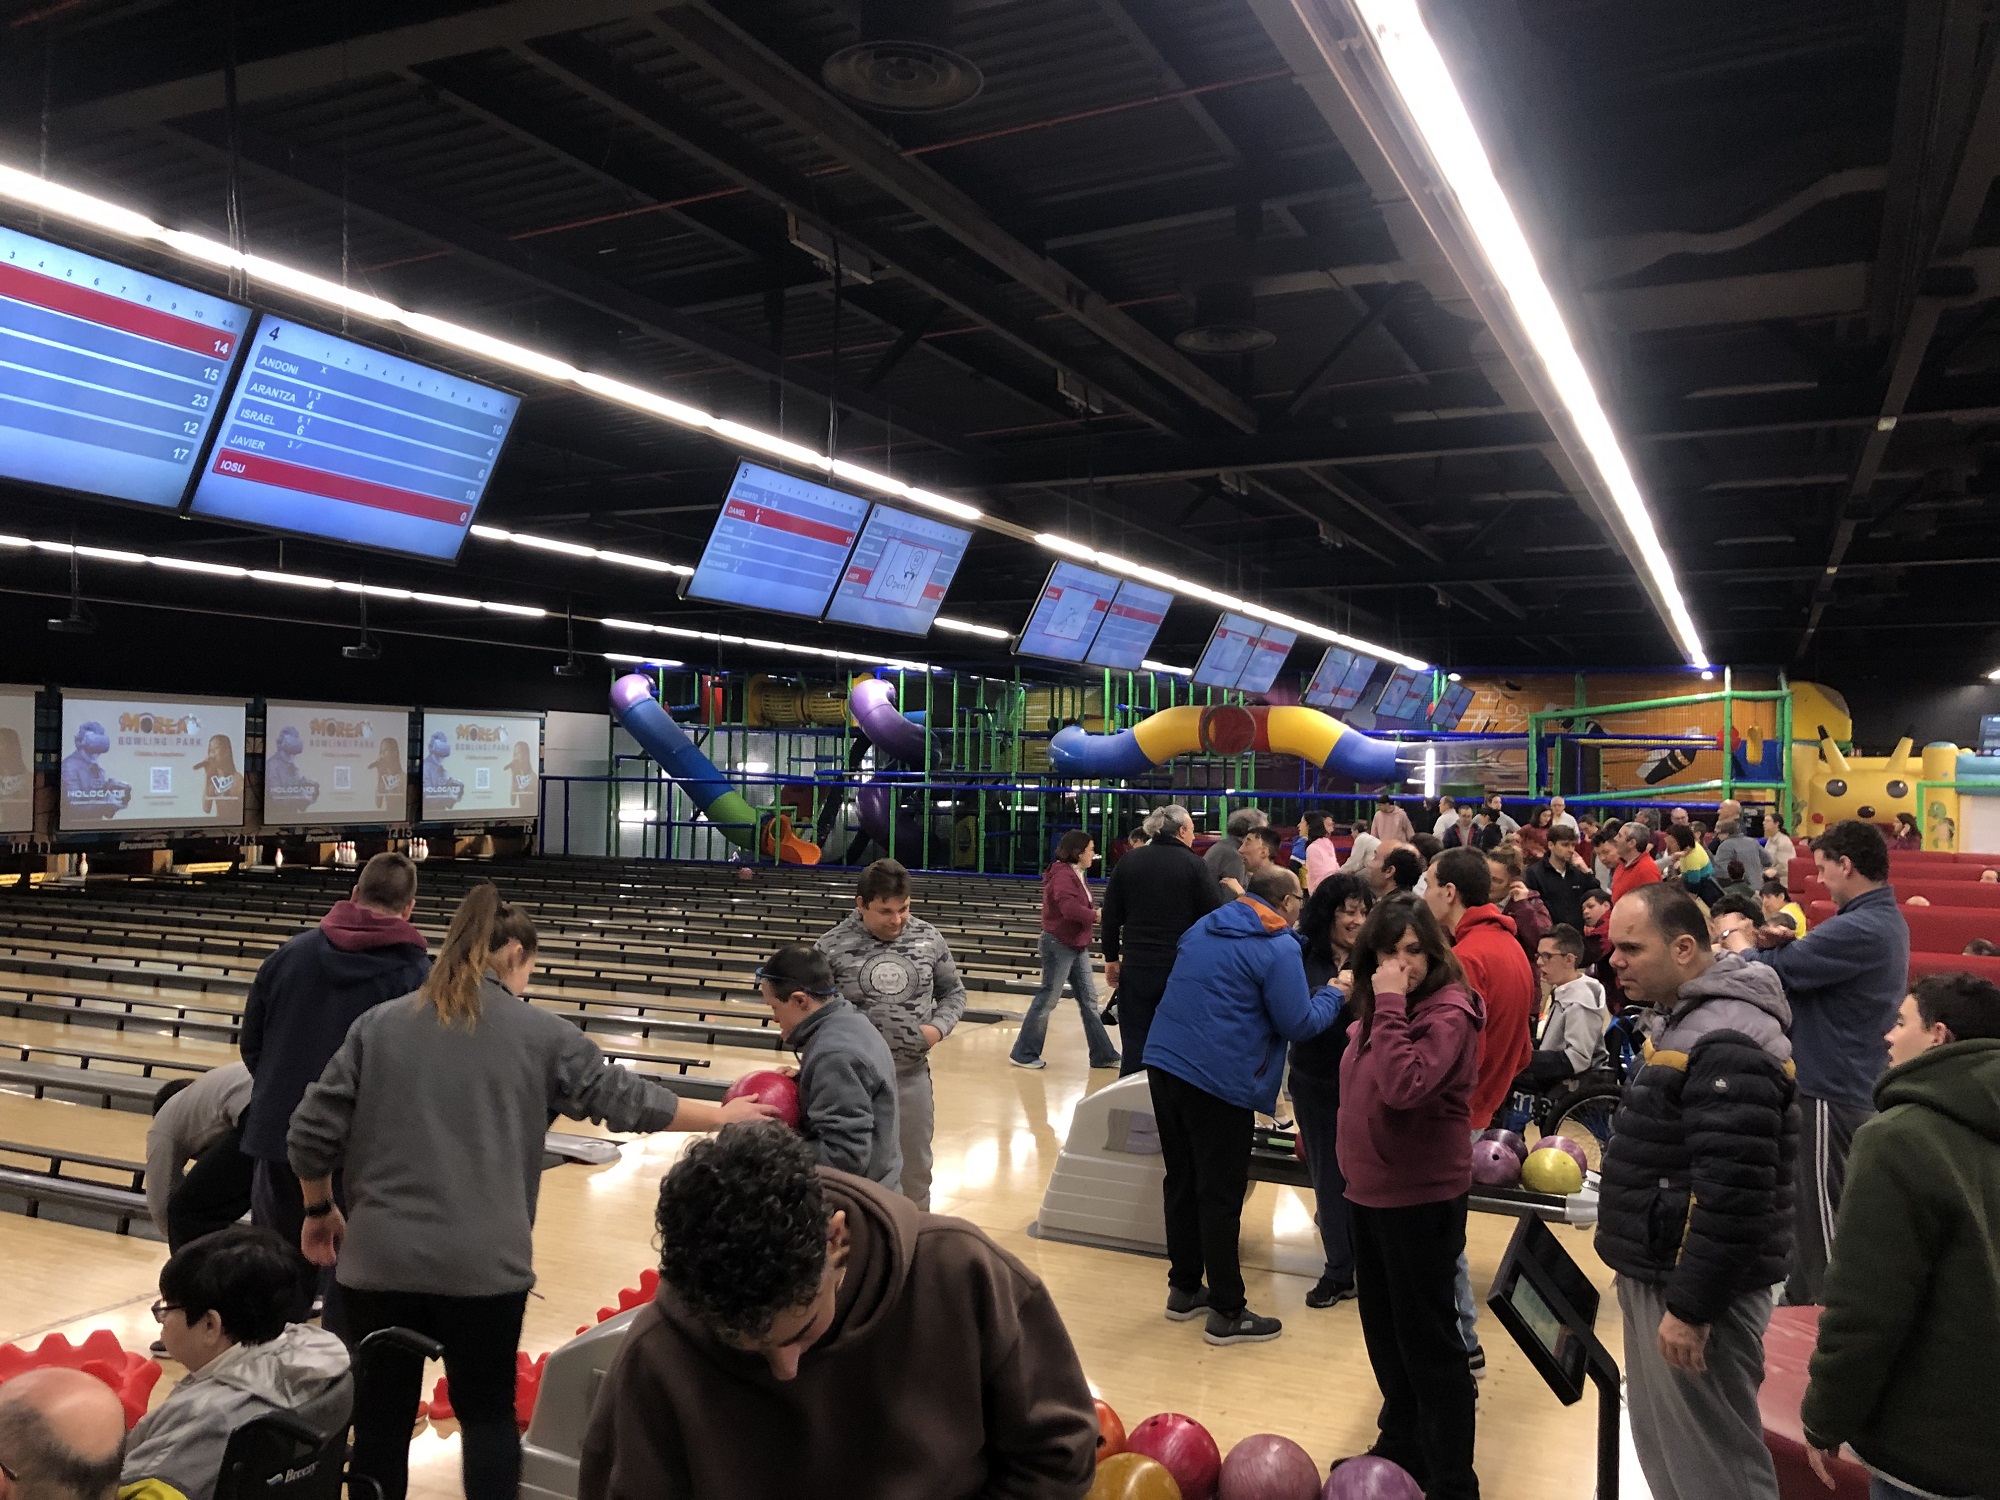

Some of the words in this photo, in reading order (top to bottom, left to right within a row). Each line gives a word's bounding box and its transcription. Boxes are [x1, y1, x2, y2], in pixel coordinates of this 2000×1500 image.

[9, 250, 16, 260] 3
[38, 260, 45, 268] 4
[66, 269, 73, 277] 5
[93, 277, 100, 286] 6
[120, 286, 127, 294] 7
[145, 294, 152, 302] 8
[170, 302, 177, 310] 9
[194, 310, 203, 318] 10
[268, 326, 281, 341] 4
[213, 340, 229, 355] 14
[203, 366, 219, 381] 15
[191, 393, 209, 408] 23
[259, 356, 300, 375] ANDONI
[319, 366, 328, 374] X
[492, 424, 503, 435] 10
[250, 382, 297, 403] ARANTZA
[305, 400, 315, 411] 4
[486, 447, 494, 457] 4
[182, 420, 199, 435] 12
[240, 408, 276, 426] ISRAEL
[296, 424, 305, 435] 6
[478, 468, 485, 479] 6
[173, 448, 189, 461] 17
[230, 435, 266, 450] JAVIER
[465, 489, 476, 500] 10
[741, 468, 749, 479] 5
[220, 460, 246, 474] IOSU
[459, 511, 467, 522] 0
[728, 506, 746, 517] DANIEL
[118, 736, 167, 746] BOWLING
[176, 738, 201, 746] PARK
